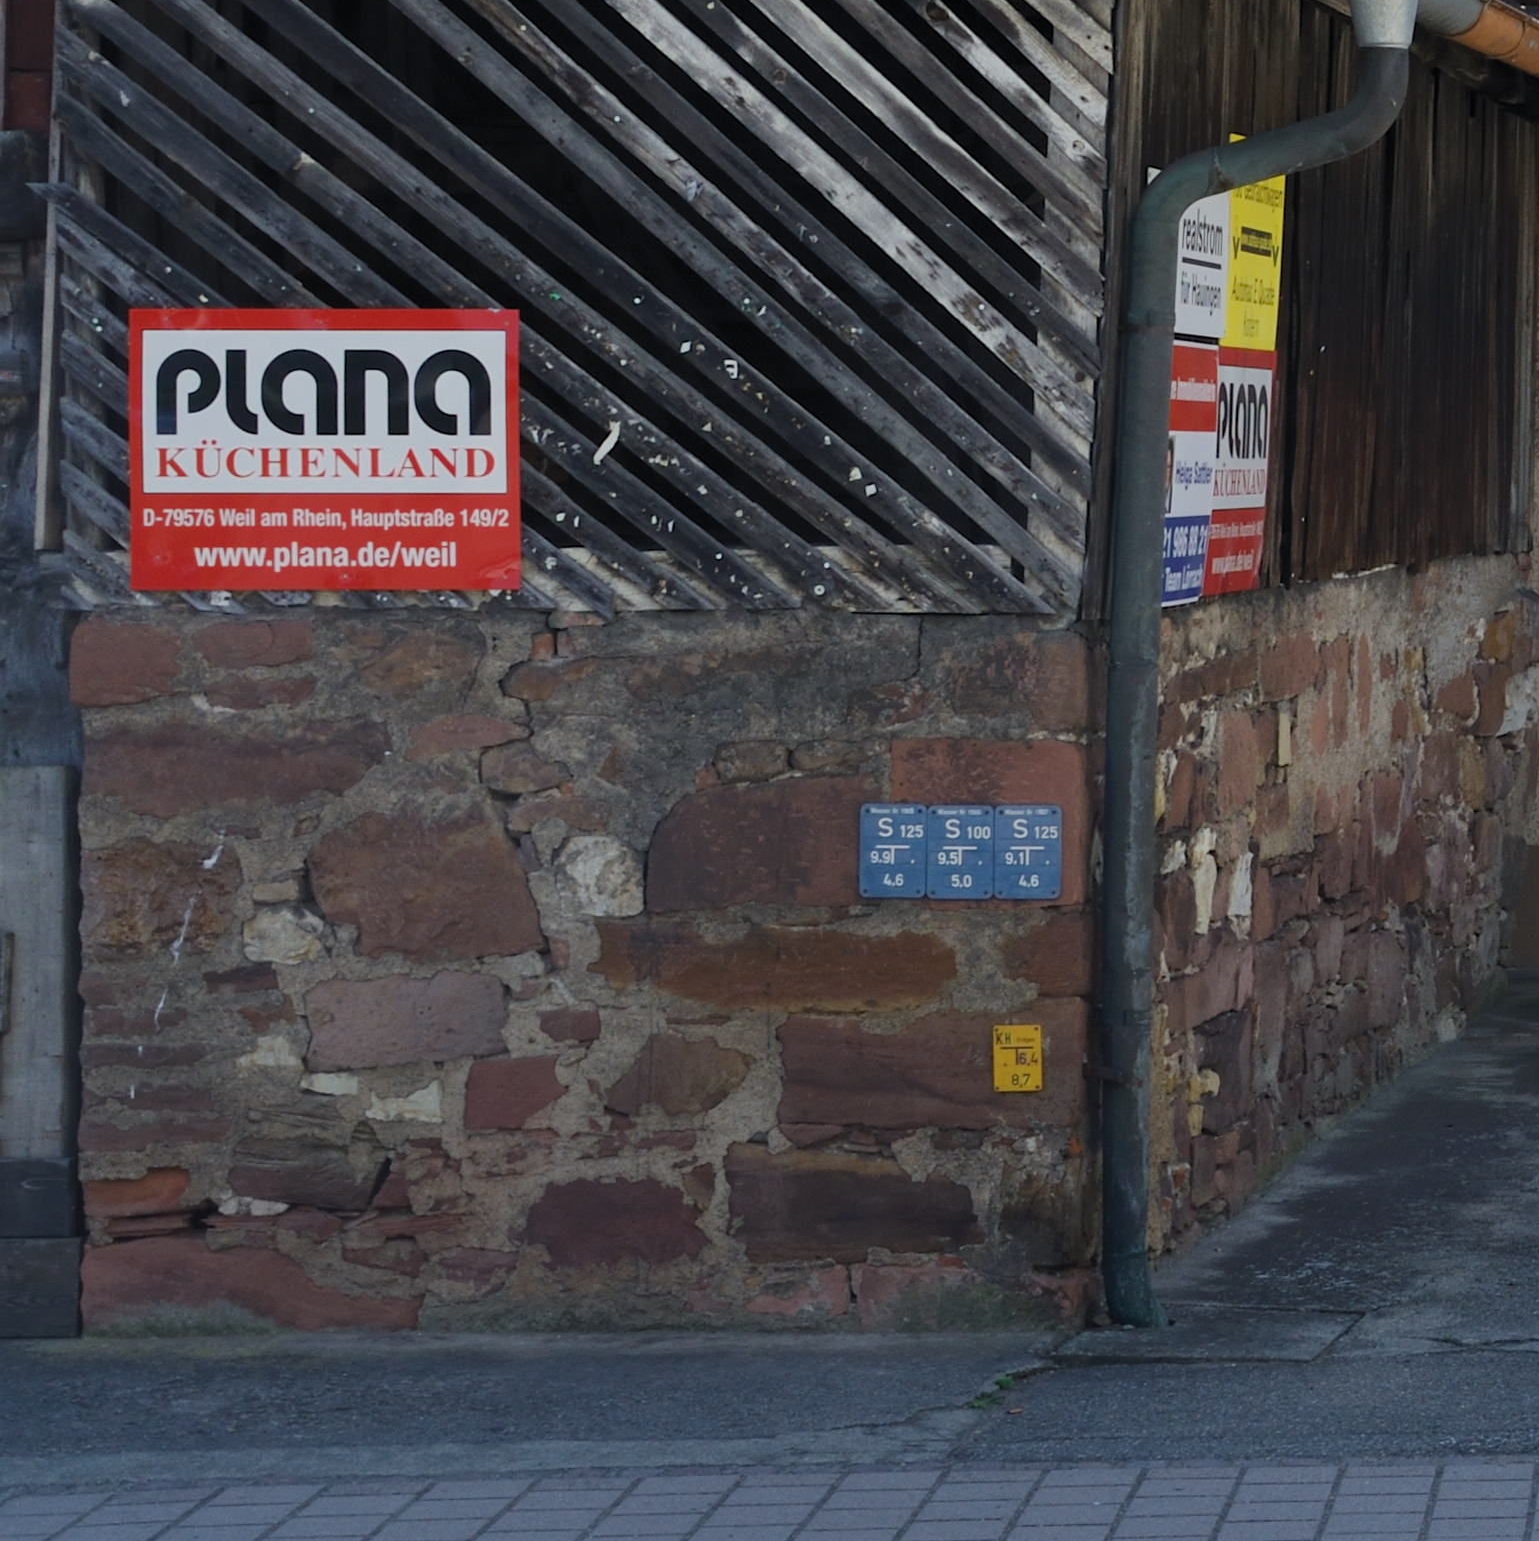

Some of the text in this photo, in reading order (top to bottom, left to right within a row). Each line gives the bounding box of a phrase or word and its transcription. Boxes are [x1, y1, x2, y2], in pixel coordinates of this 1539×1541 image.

[1181, 208, 1223, 256] realstrom
[156, 439, 496, 479] KÜCHENLAND
[1213, 464, 1265, 497] KÜCHENLAND
[143, 508, 509, 531] D-79576 Weil am Rhein, Hauptstraße 149/2
[194, 541, 456, 572] www.plana.de/weil
[1165, 566, 1182, 592] Team
[877, 817, 924, 839] S 125
[945, 818, 991, 840] S 100
[1012, 818, 1058, 840] S 125
[1018, 1052, 1038, 1067] 6,4
[1011, 1073, 1031, 1088] 8,7
